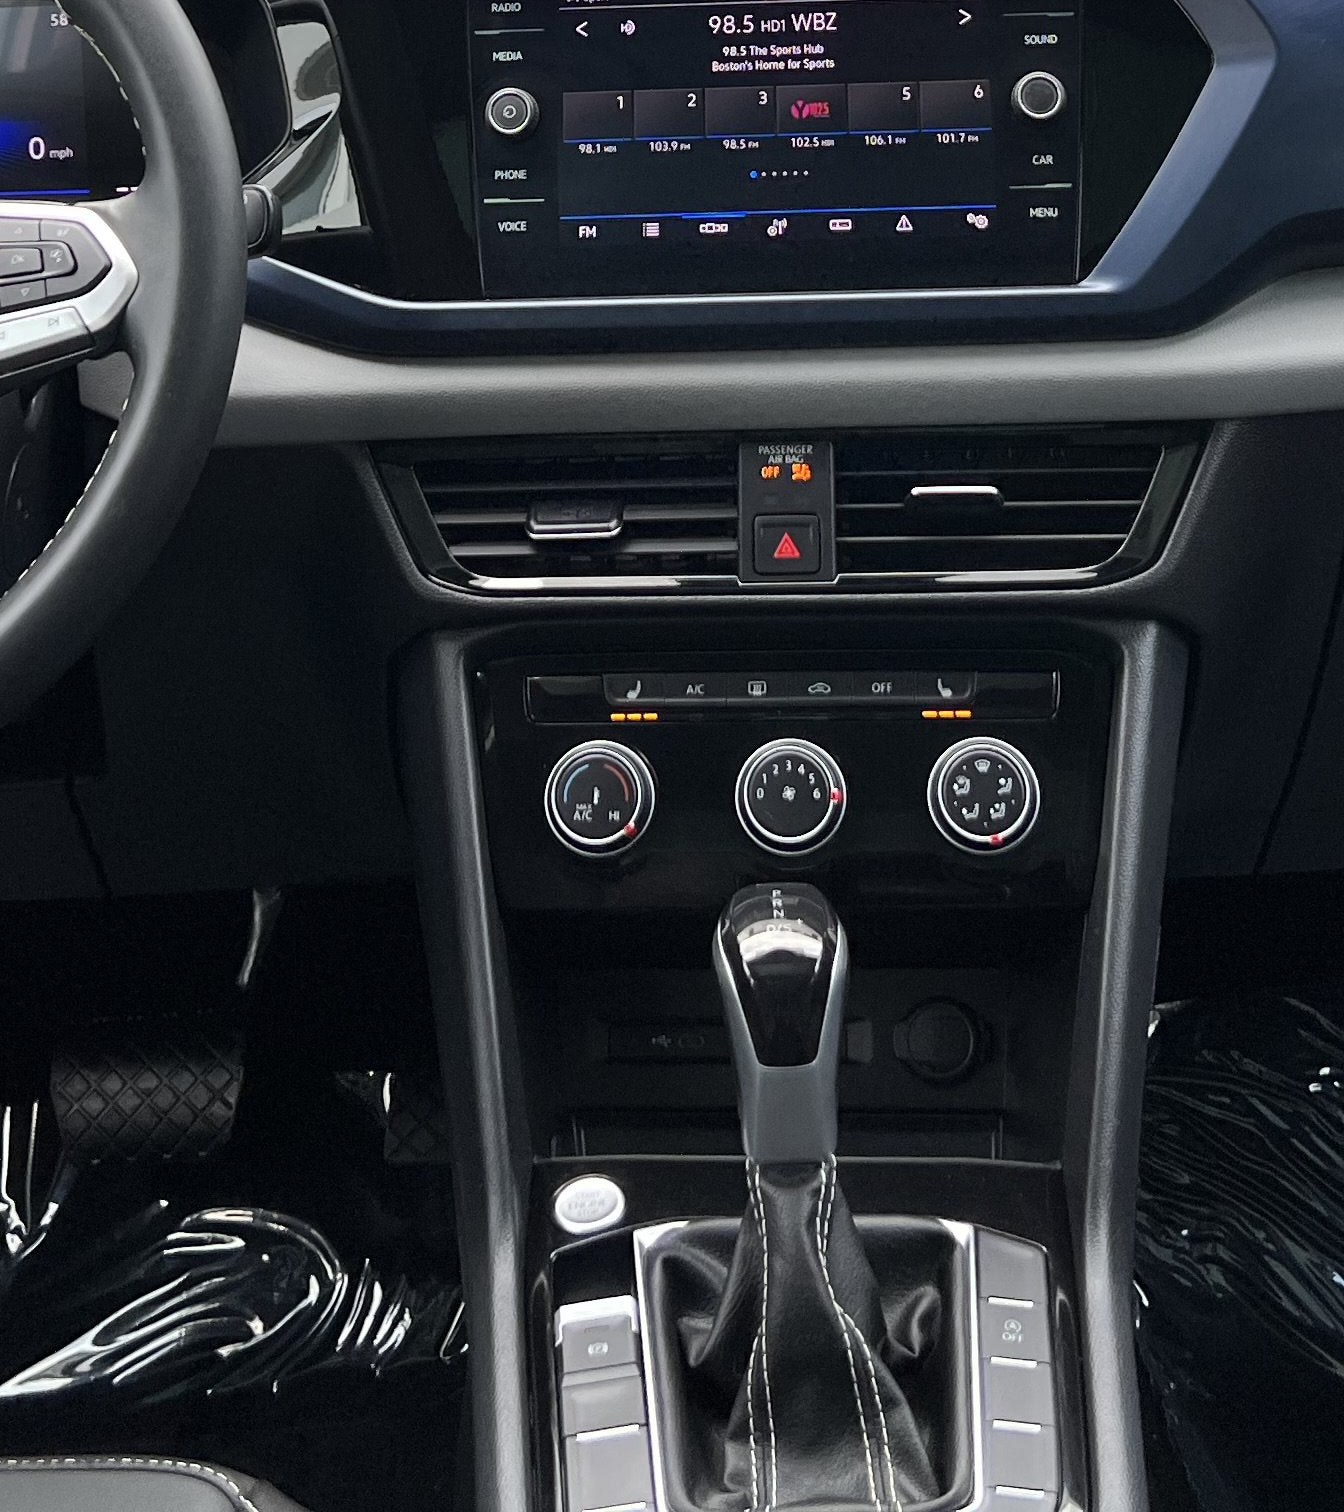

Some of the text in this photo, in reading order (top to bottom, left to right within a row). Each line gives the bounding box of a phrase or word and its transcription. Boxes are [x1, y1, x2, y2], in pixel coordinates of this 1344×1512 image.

[491, 2, 522, 13] RADIO
[709, 12, 838, 34] 98.5 HD1 WBZ
[1024, 34, 1058, 45] SOUND
[492, 51, 523, 62] MEDIA
[722, 43, 824, 58] 98.5 The Sports Hub
[712, 57, 835, 72] Boston's Home for Sports
[758, 90, 768, 105] 3
[902, 86, 912, 101] 5
[974, 84, 984, 99] 6
[616, 95, 625, 110] 1
[687, 93, 697, 108] 2
[722, 139, 746, 150] 98.5
[791, 137, 819, 148] 102.5
[864, 134, 893, 146] 106.1
[936, 133, 965, 144] 101.7
[28, 136, 74, 160] 0 mph
[578, 143, 601, 155] 98.1
[649, 141, 678, 152] 103.9
[1032, 154, 1054, 165] CAR
[494, 170, 527, 180] PHONE
[1029, 207, 1059, 218] MENU
[498, 221, 527, 232] VOICE
[578, 225, 597, 238] FM
[758, 445, 813, 455] PASSENGER
[768, 454, 804, 464] AIR BAG
[761, 465, 780, 479] OFF
[686, 683, 705, 695] A/C
[871, 682, 893, 694] OFF
[772, 764, 779, 775] 2
[785, 759, 792, 771] 3
[797, 763, 805, 775] 4
[762, 773, 767, 784] 1
[808, 773, 815, 784] 5
[756, 787, 764, 800] 0
[813, 788, 821, 800] 6
[573, 810, 592, 822] A/C
[608, 810, 620, 822] HI
[773, 908, 785, 919] N
